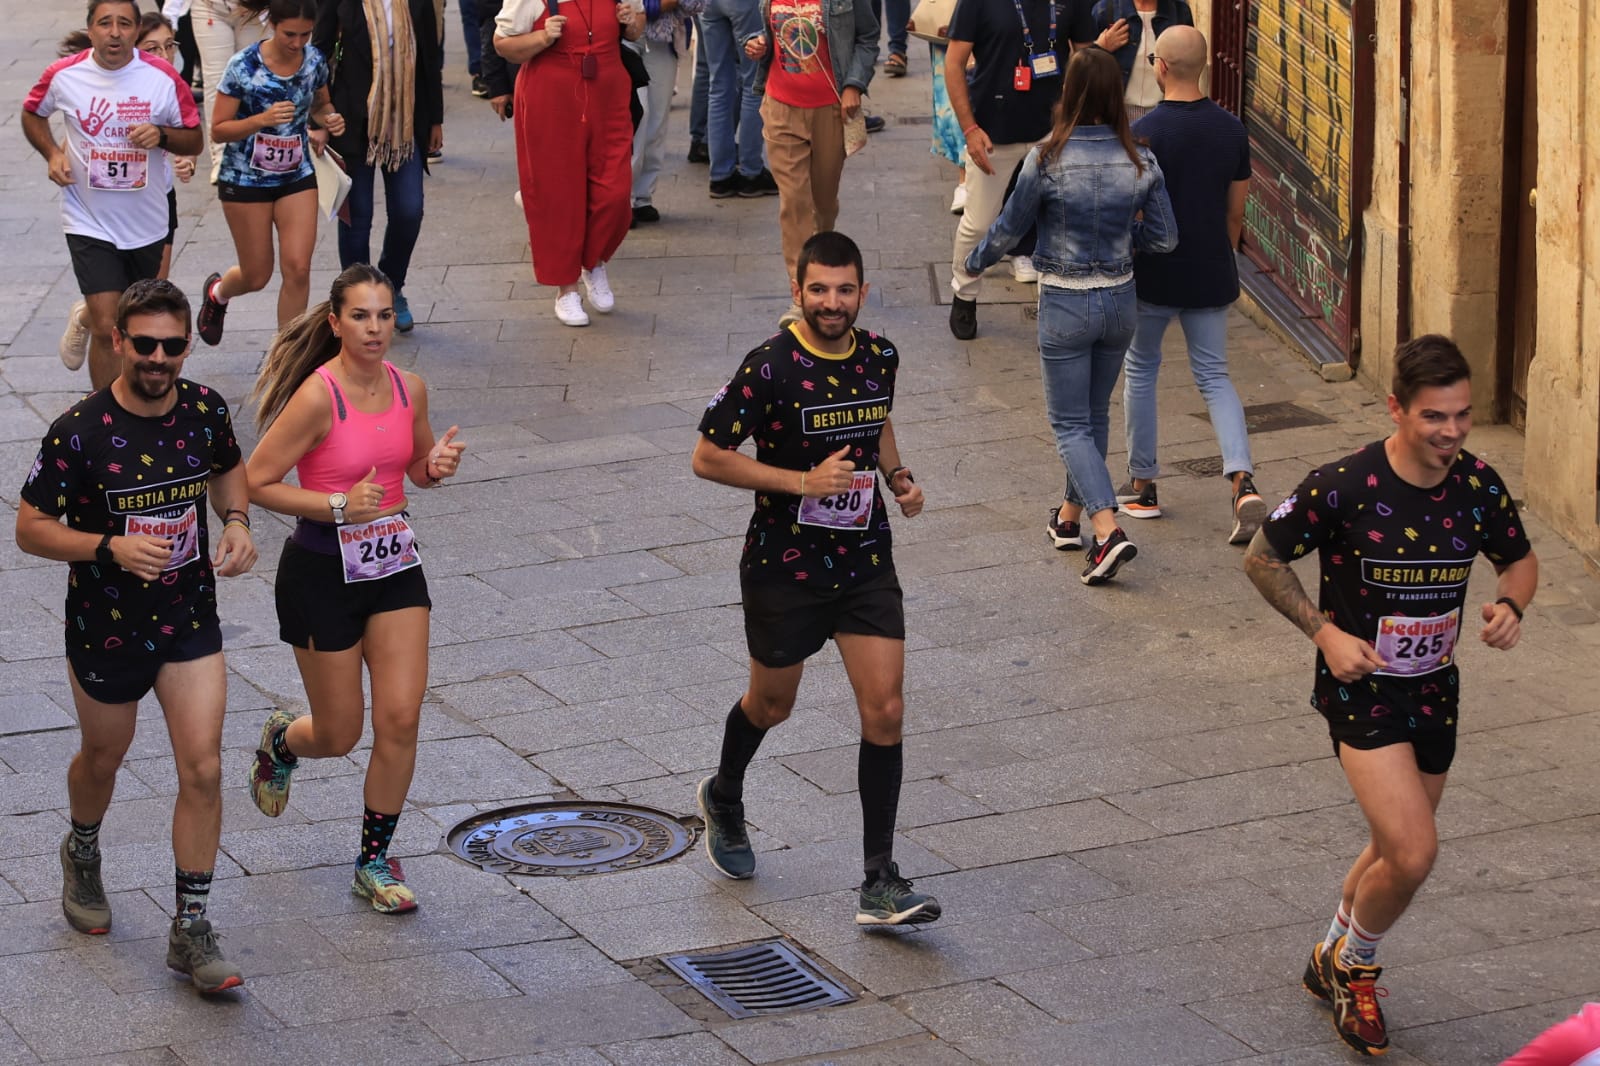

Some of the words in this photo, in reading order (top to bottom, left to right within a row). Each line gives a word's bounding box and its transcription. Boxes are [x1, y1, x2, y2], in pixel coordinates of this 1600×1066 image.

[264, 147, 294, 163] 311
[107, 162, 129, 178] 51
[813, 409, 854, 429] BESTIA
[117, 490, 166, 510] BESTIA
[818, 490, 861, 512] 480
[359, 534, 402, 564] 266
[1373, 567, 1425, 583] BESTIA
[1395, 633, 1445, 659] 265
